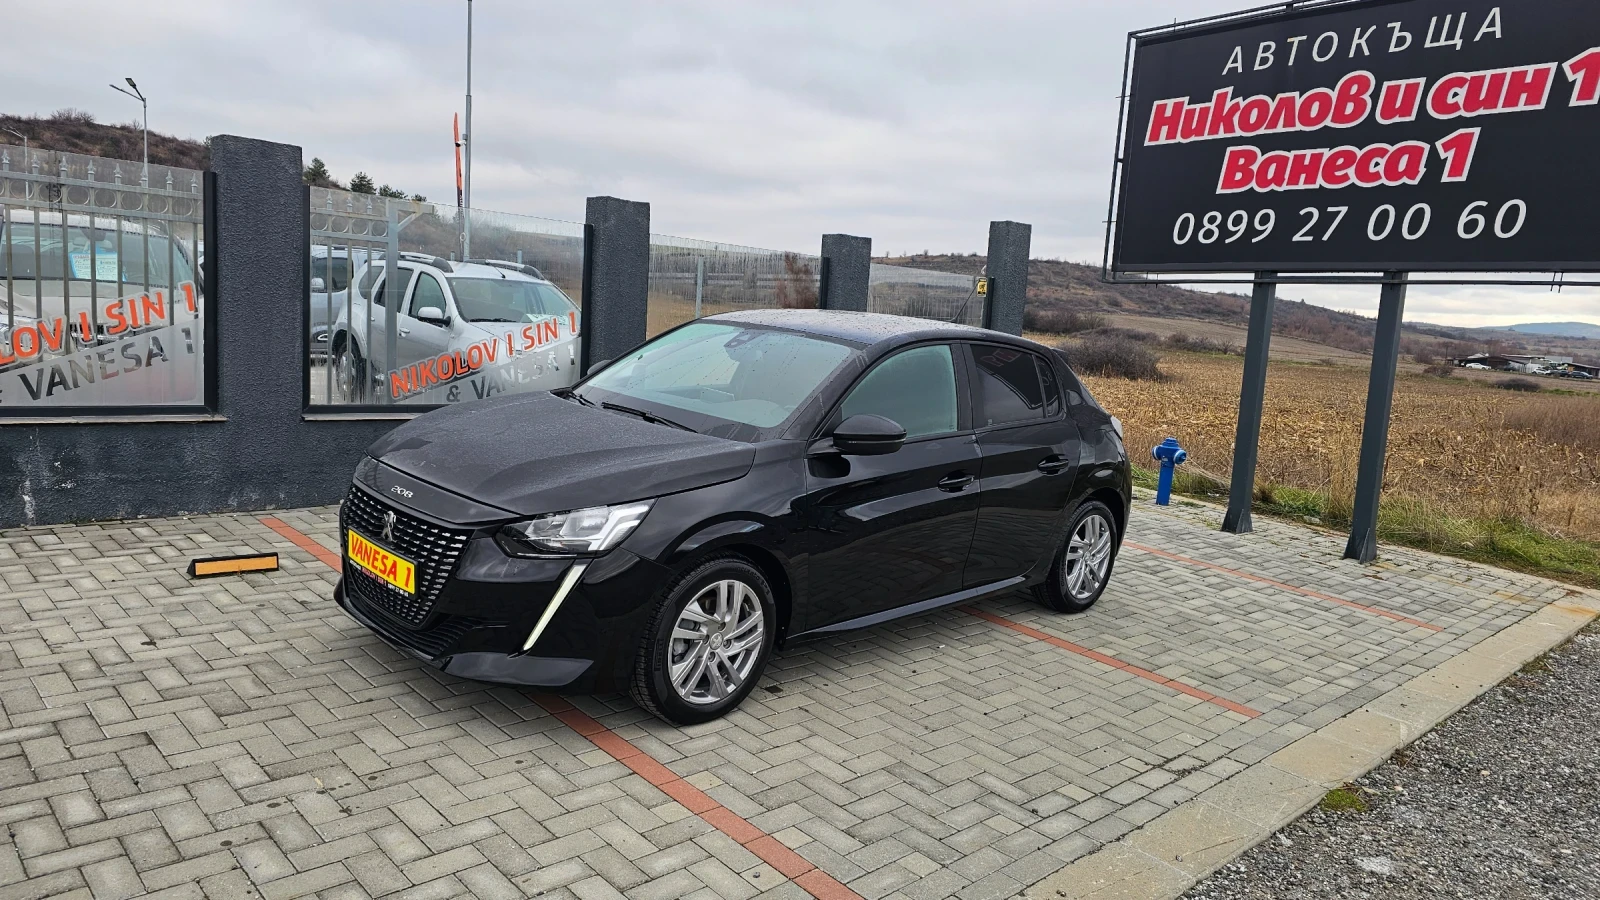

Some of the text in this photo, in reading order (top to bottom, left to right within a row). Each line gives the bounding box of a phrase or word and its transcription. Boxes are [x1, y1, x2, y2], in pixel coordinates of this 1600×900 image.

[1221, 6, 1502, 75] АВТОКЪЩА
[1144, 46, 1600, 146] Николов и син 1
[1215, 126, 1481, 194] Ванеса 1
[1172, 198, 1527, 245] 0899 27 00 60
[78, 311, 91, 342] I
[105, 291, 166, 335] SIN
[180, 283, 196, 313] 1
[17, 326, 195, 401] VANESA 1
[390, 338, 499, 398] NIKOLOV
[506, 332, 516, 357] I
[522, 317, 559, 351] SIN
[567, 310, 578, 334] 1
[445, 343, 576, 402] & VANESA 1
[390, 485, 413, 498] 208
[351, 533, 398, 583] VANESA
[404, 566, 412, 589] 1
